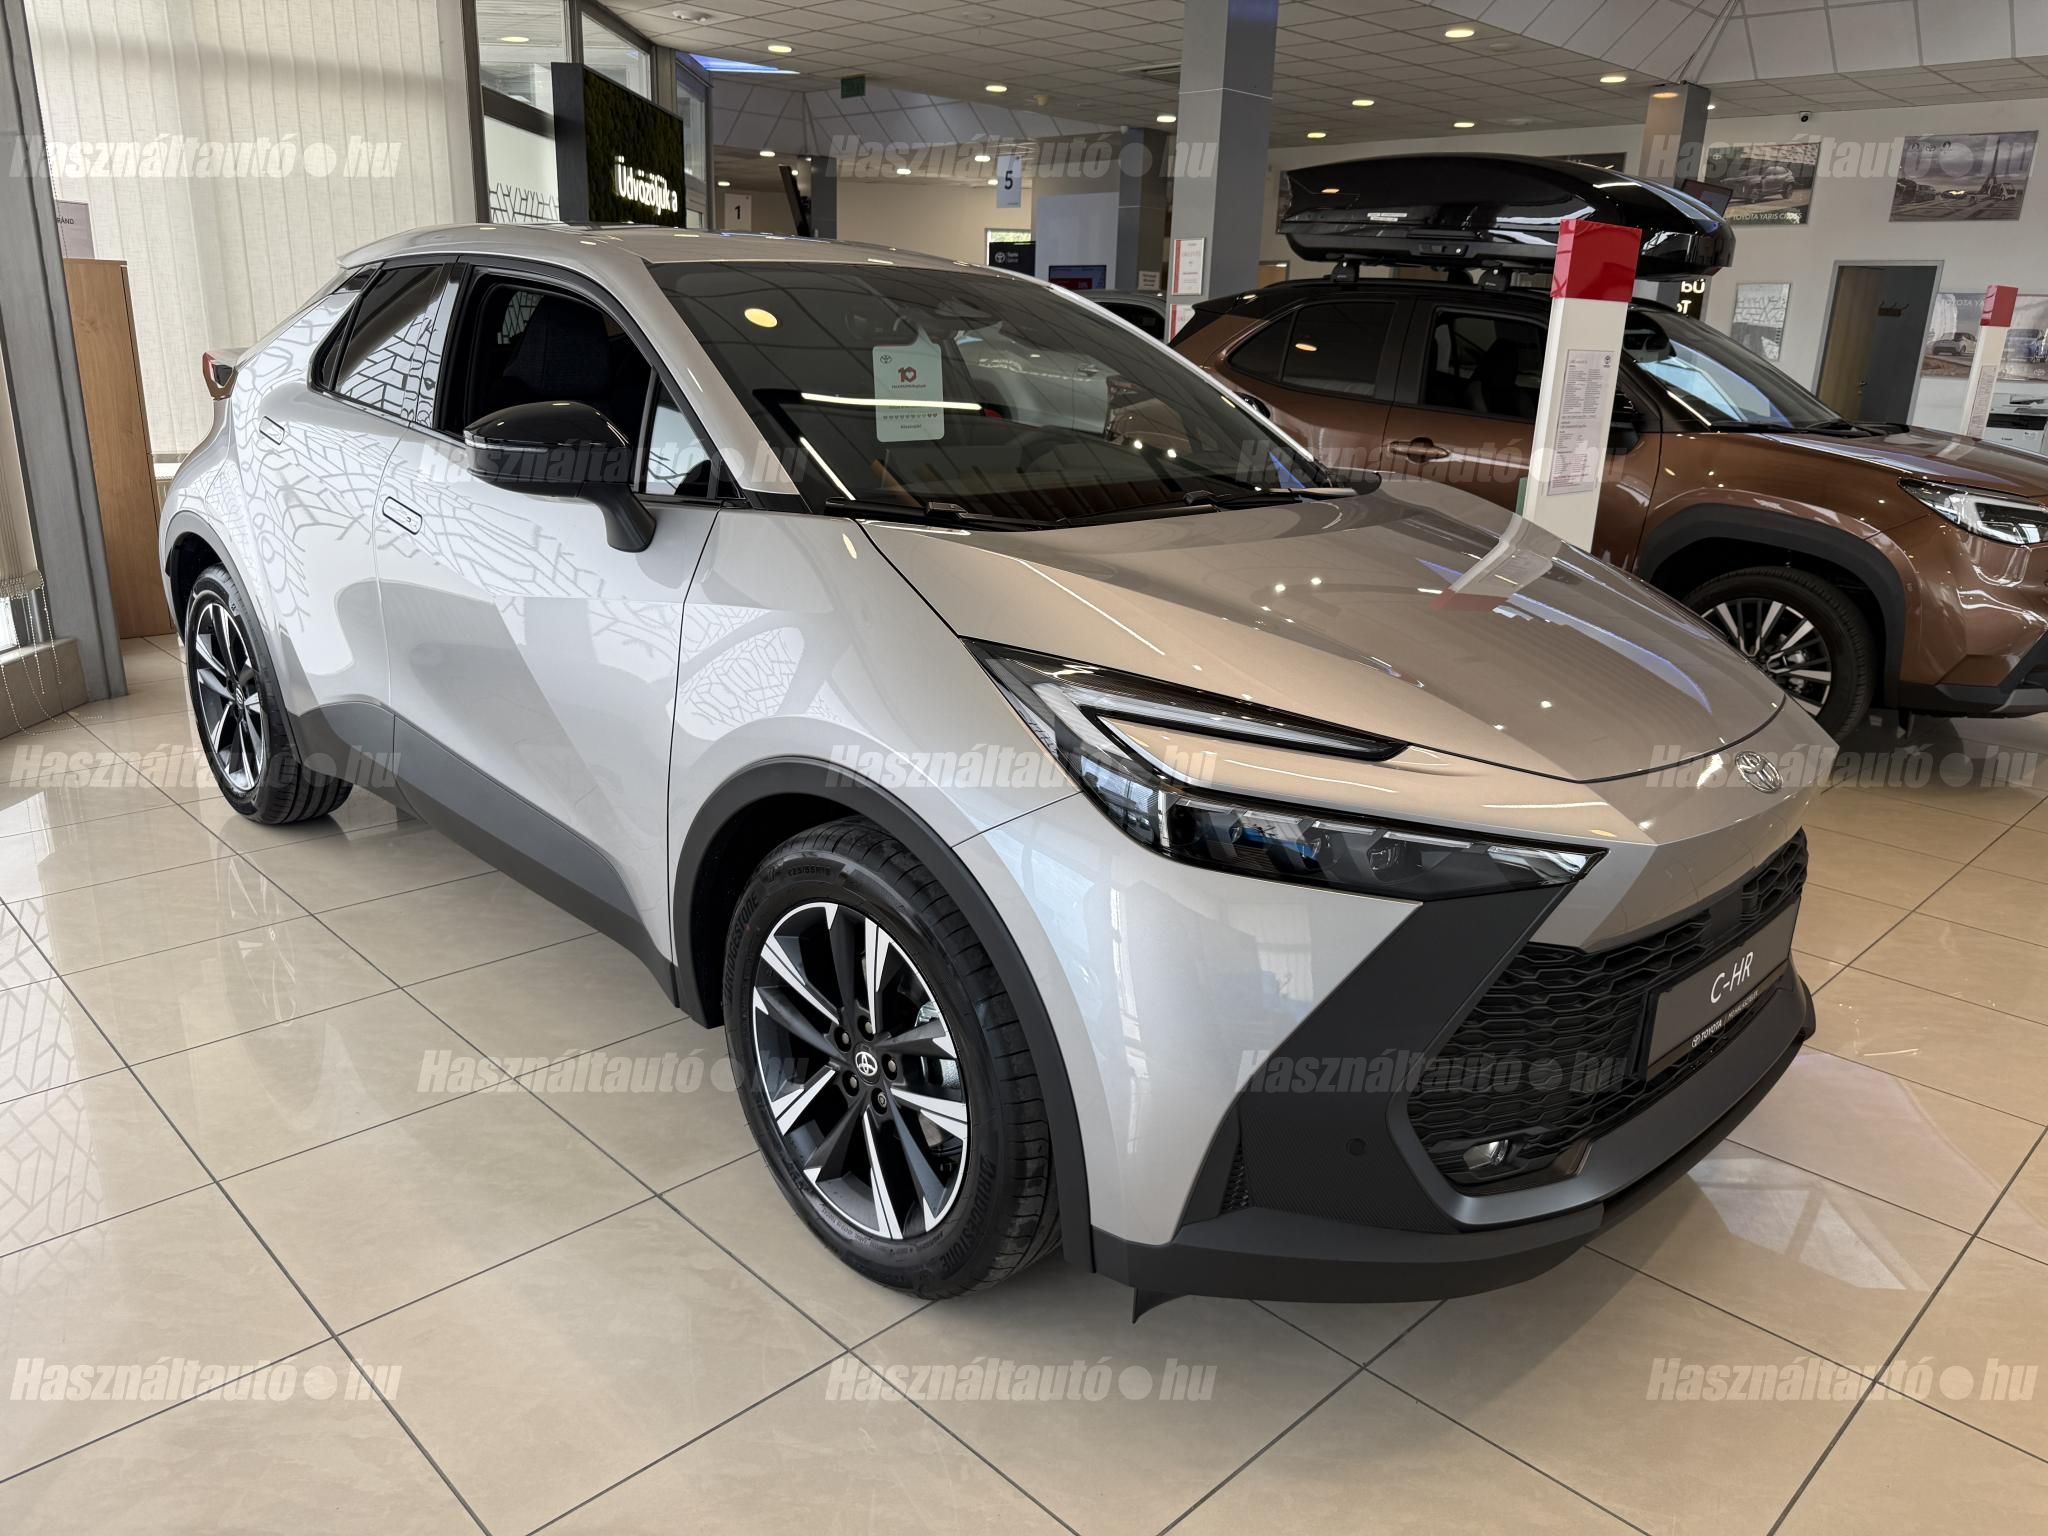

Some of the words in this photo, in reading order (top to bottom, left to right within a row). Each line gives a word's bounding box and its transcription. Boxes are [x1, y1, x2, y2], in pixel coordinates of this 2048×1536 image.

[1004, 170, 1014, 190] 5
[734, 204, 741, 220] 1
[1710, 951, 1754, 1004] C-HR
[1701, 1019, 1722, 1041] TOYOTA
